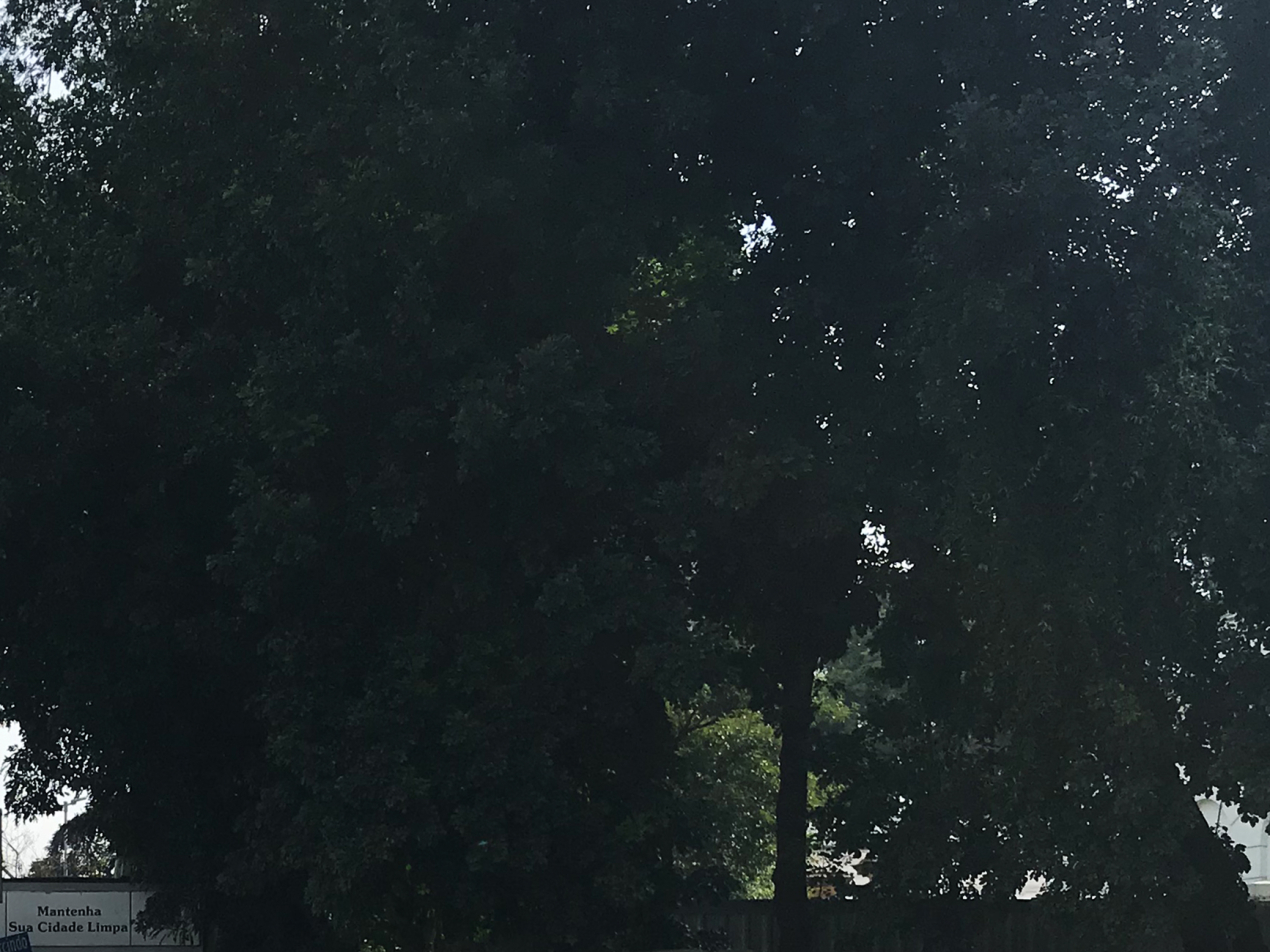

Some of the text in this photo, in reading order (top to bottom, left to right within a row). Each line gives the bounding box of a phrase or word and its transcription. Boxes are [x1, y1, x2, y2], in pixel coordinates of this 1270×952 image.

[37, 906, 102, 916] Mantenha
[9, 921, 129, 935] Sua Cidade Limpa
